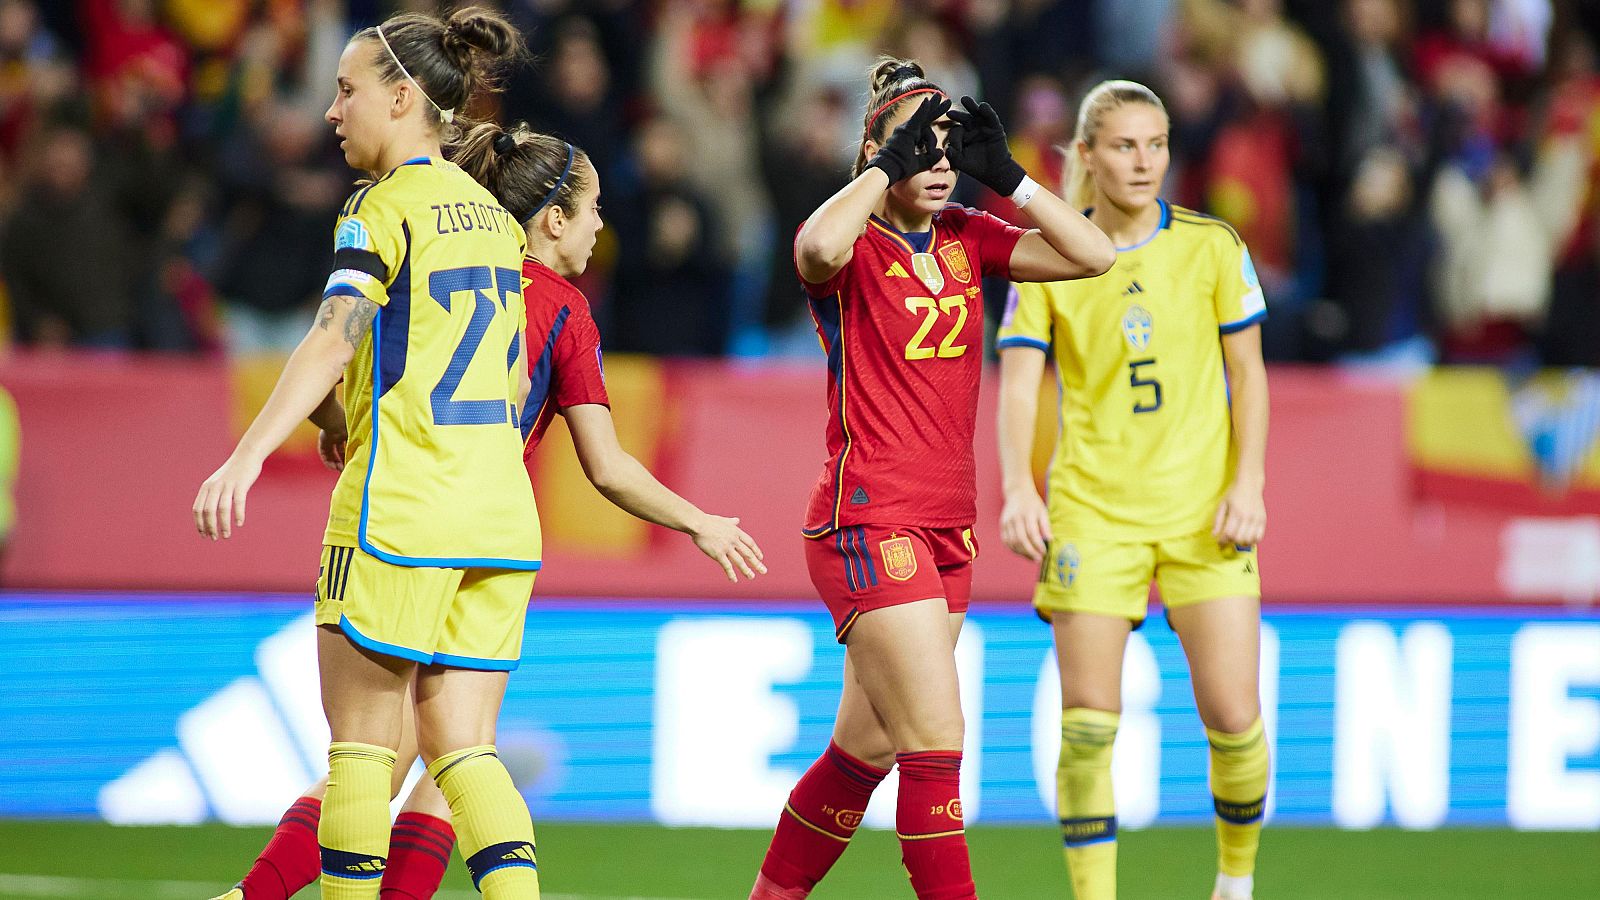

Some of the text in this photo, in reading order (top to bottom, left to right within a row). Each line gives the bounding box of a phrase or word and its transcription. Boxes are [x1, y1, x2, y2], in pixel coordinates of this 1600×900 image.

[905, 295, 968, 361] 22
[1129, 358, 1162, 414] 5
[930, 805, 944, 815] 19
